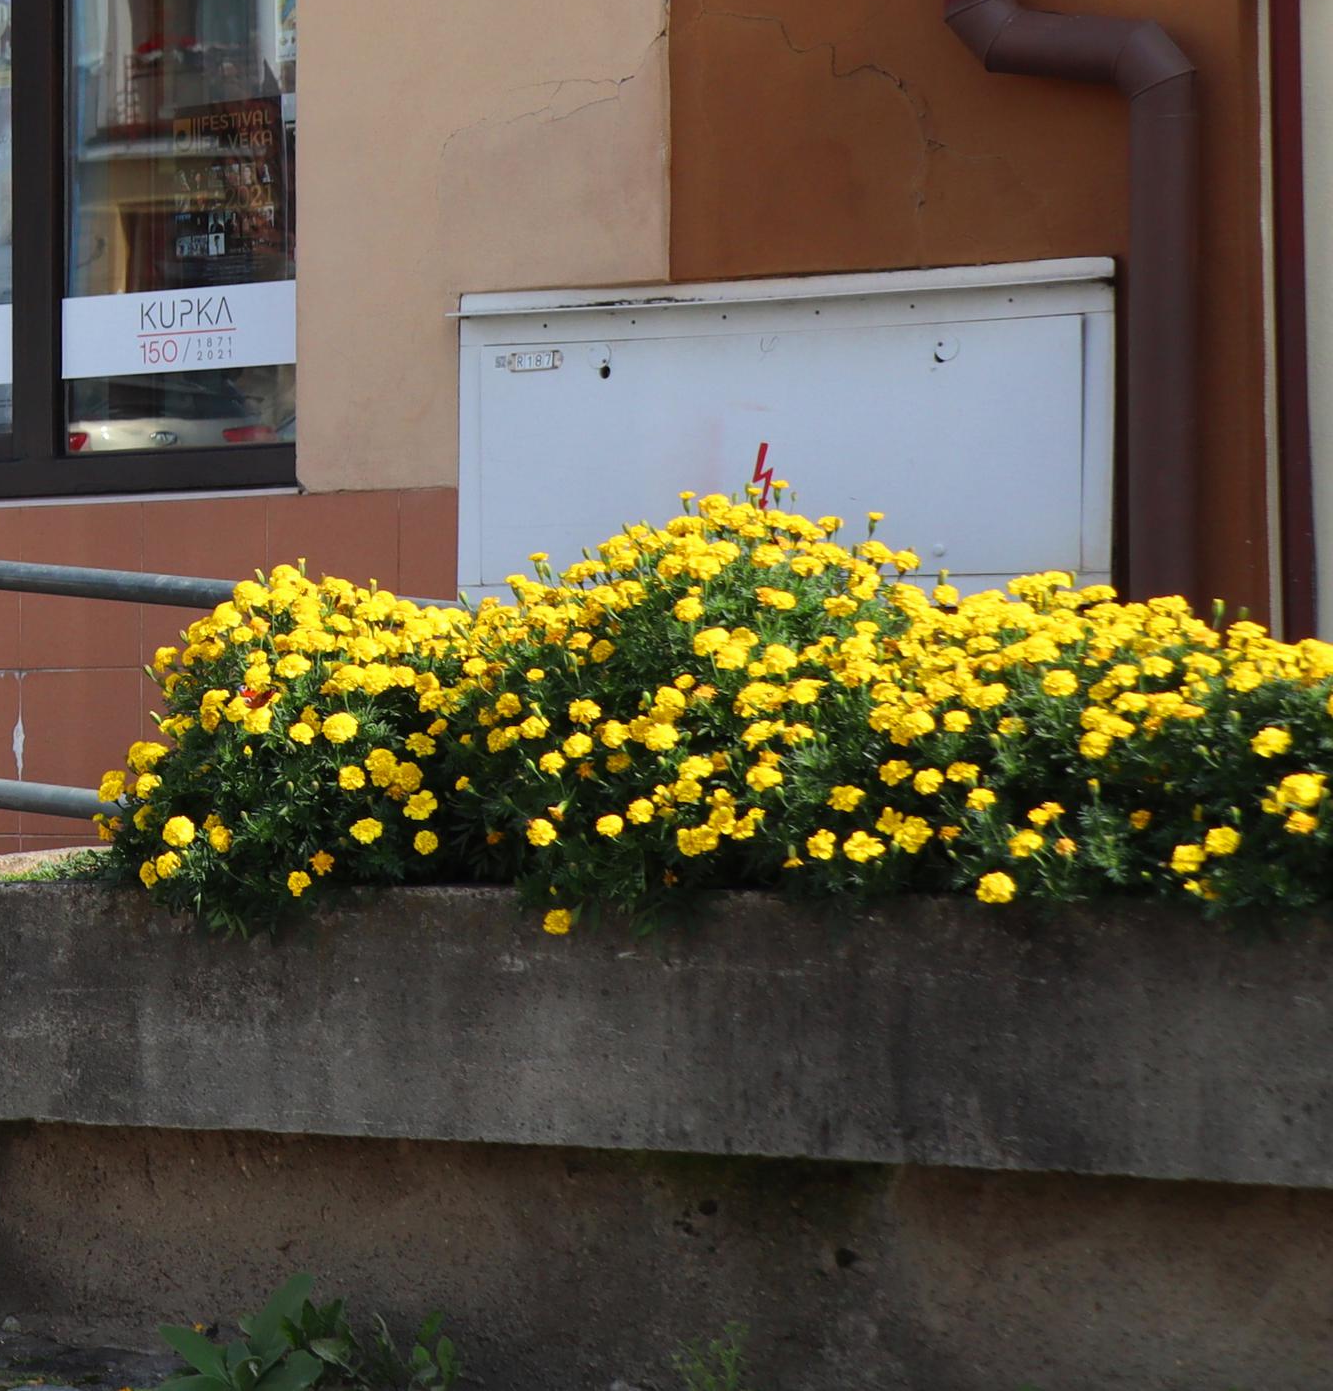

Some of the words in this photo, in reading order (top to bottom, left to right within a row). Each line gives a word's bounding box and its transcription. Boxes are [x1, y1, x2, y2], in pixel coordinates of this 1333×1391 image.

[201, 109, 272, 132] FESTIVAL
[225, 183, 274, 209] 2021
[140, 296, 234, 330] KUPKA
[196, 336, 233, 348] 1871
[196, 348, 233, 361] 2021
[516, 353, 552, 368] R187
